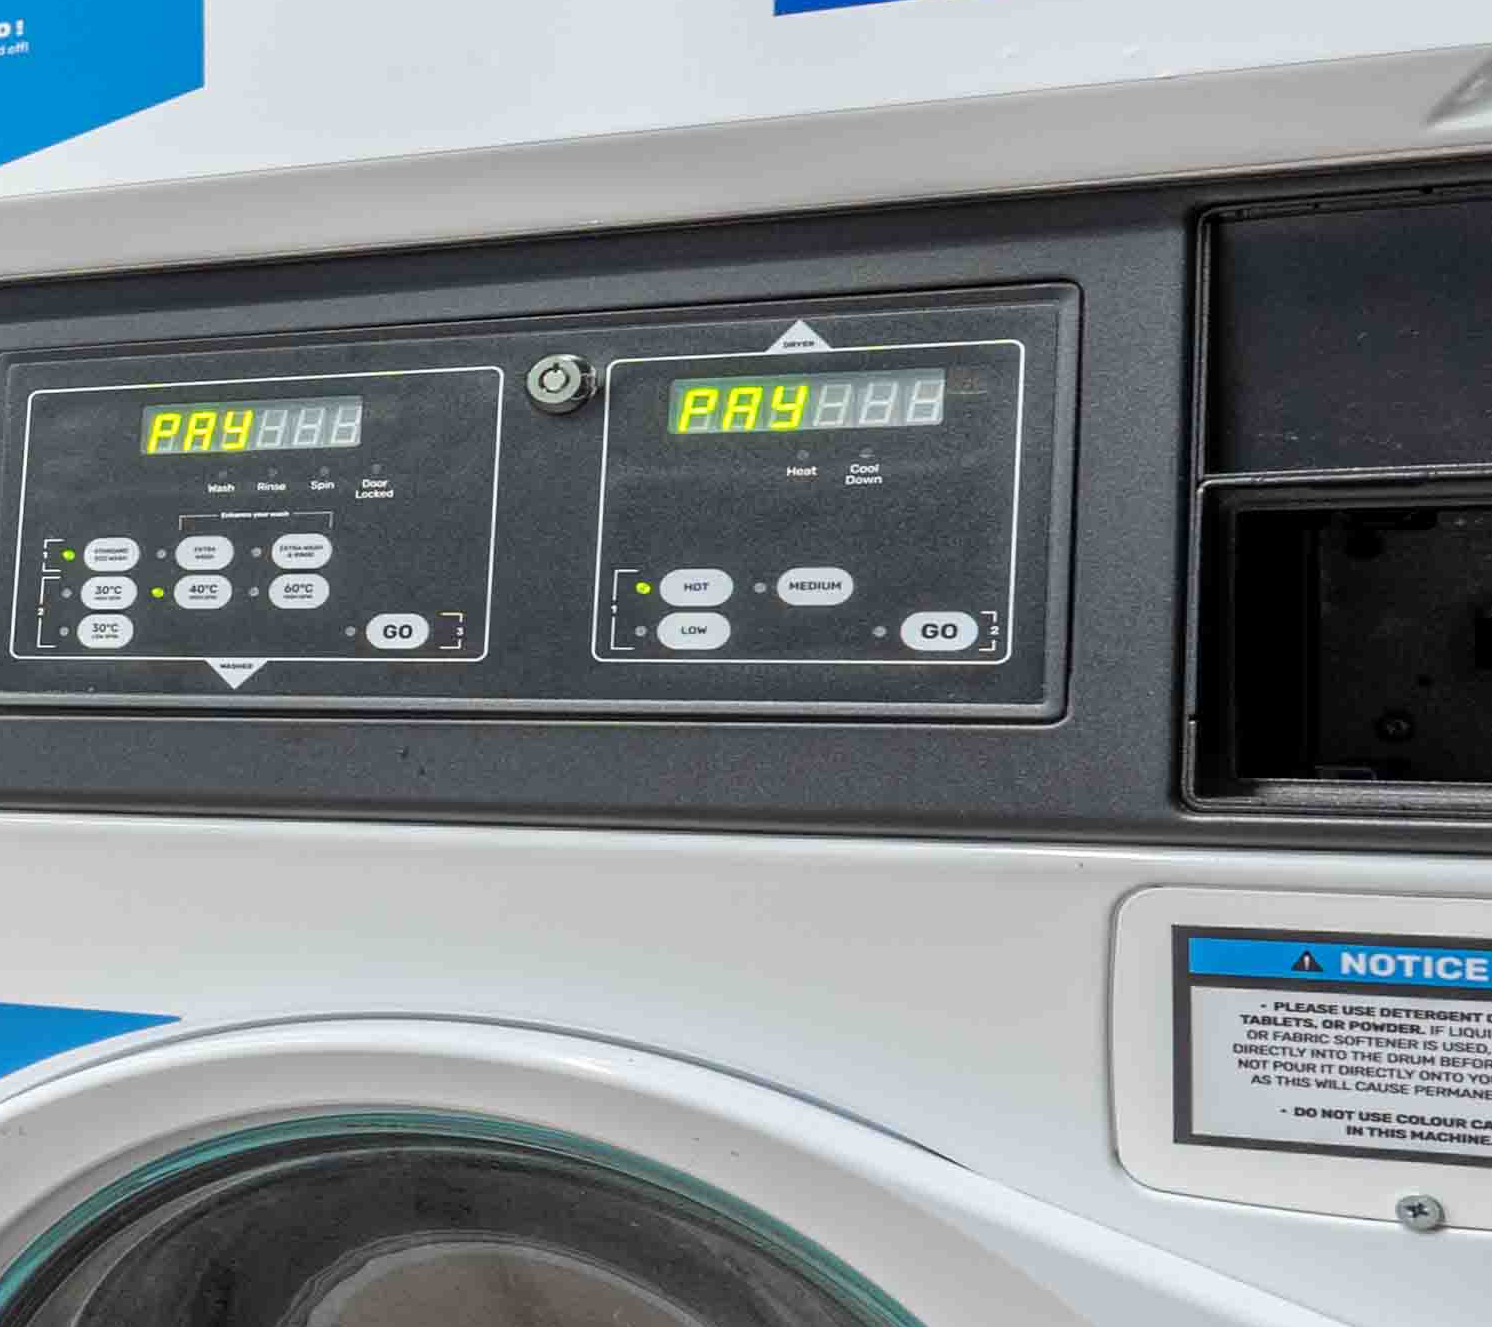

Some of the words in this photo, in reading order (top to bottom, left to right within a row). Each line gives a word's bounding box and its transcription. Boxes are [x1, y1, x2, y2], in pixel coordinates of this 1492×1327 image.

[677, 385, 810, 434] PAY
[146, 409, 255, 455] PAY
[786, 465, 817, 477] Heat
[850, 463, 880, 474] Cool
[310, 480, 335, 491] Spin
[845, 474, 883, 485] Down
[683, 582, 709, 592] HOT
[789, 581, 842, 591] MEDIUM
[383, 624, 413, 640] GO
[681, 625, 708, 635] LOW
[921, 623, 958, 640] GO
[1341, 952, 1489, 982] NOTICE
[1273, 1001, 1339, 1015] PLEASE
[1341, 1005, 1376, 1018] USE
[1379, 1007, 1484, 1023] DETERGENT
[1241, 1014, 1318, 1030] TABLETS,
[1321, 1018, 1346, 1030] OR
[1348, 1020, 1426, 1035] POWDER.
[1430, 1025, 1445, 1035] IF
